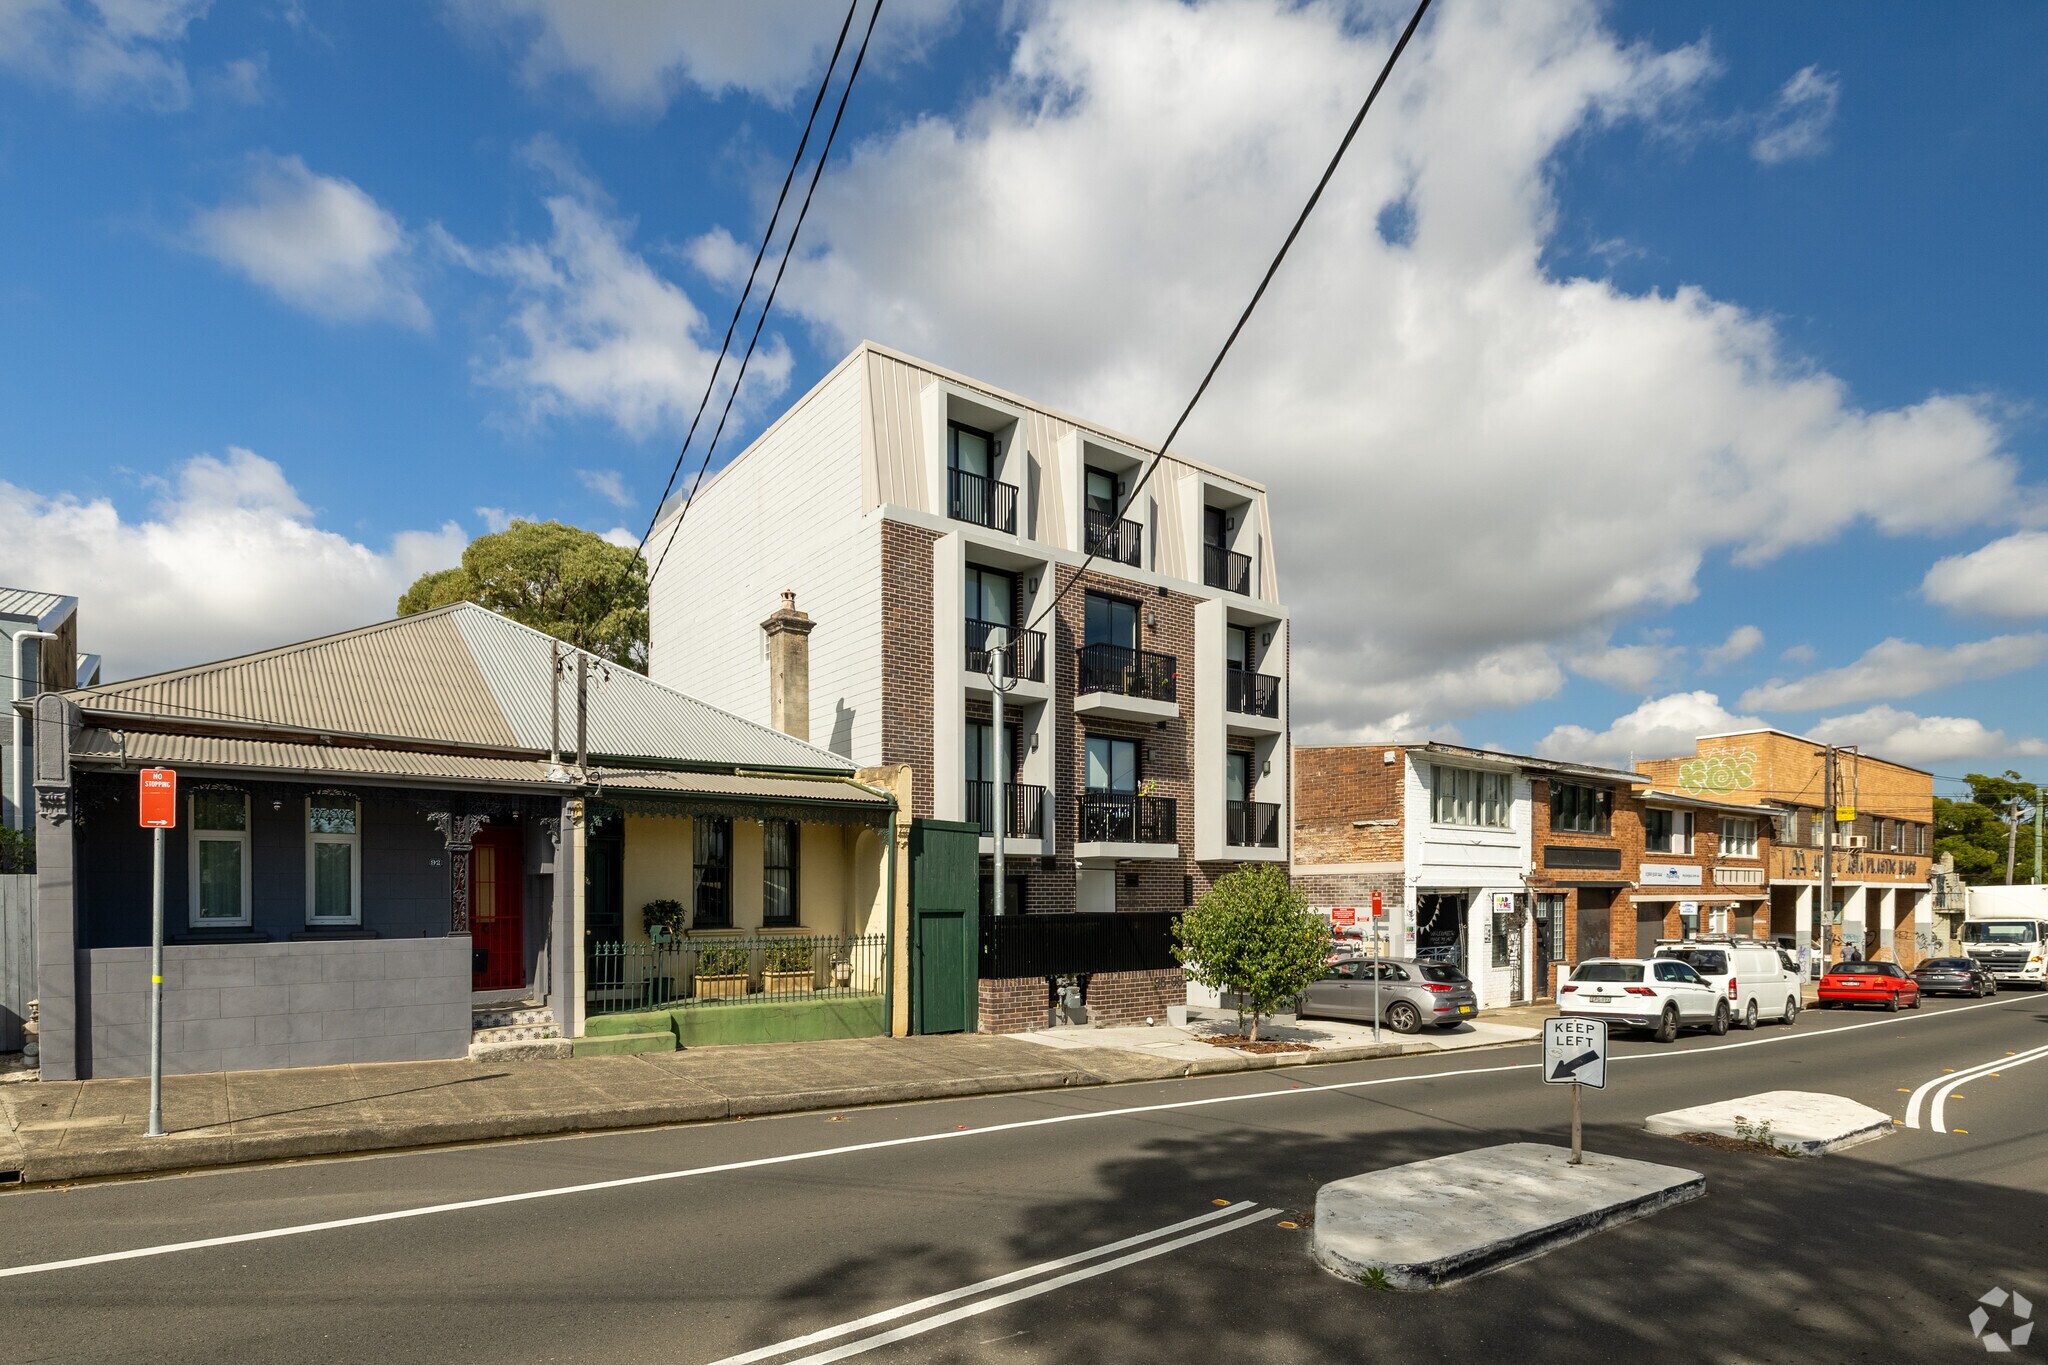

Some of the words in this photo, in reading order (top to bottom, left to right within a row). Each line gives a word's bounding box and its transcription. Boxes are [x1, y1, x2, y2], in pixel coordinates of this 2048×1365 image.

[144, 780, 171, 788] STOPPING
[1866, 857, 1897, 875] PLASTIC
[1898, 859, 1917, 876] BAGS
[1555, 1023, 1595, 1033] KEEP
[1556, 1035, 1593, 1047] LEFT
